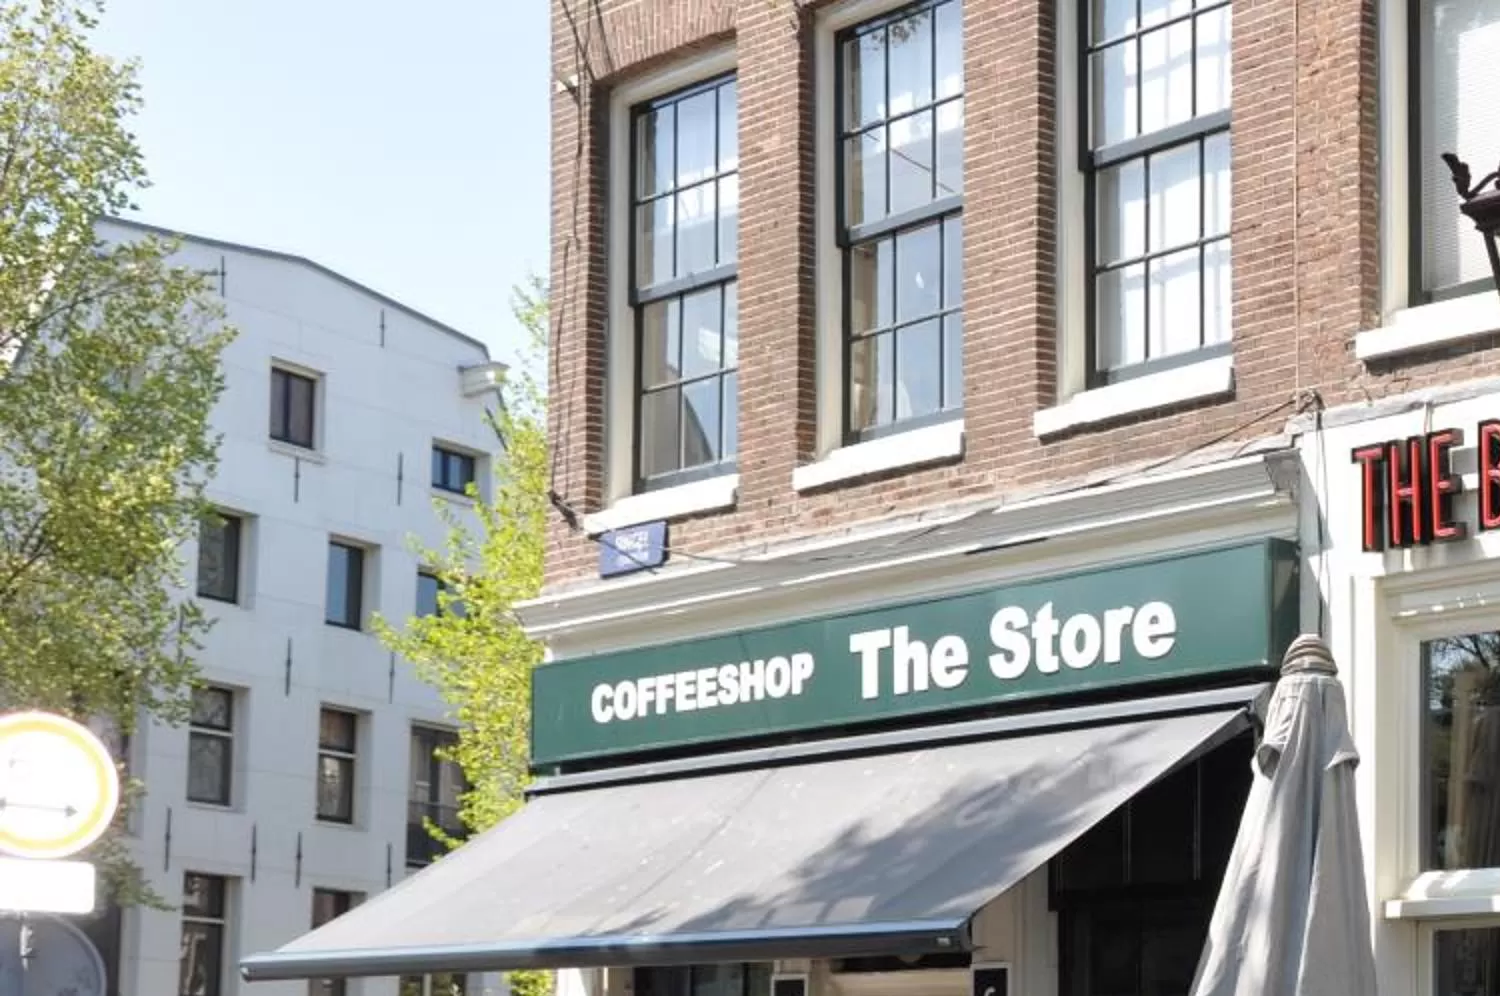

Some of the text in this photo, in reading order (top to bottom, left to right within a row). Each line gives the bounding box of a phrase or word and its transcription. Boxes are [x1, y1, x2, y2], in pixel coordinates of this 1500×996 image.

[1352, 427, 1467, 552] THE
[591, 600, 1177, 724] COFFEESHOP The Store
